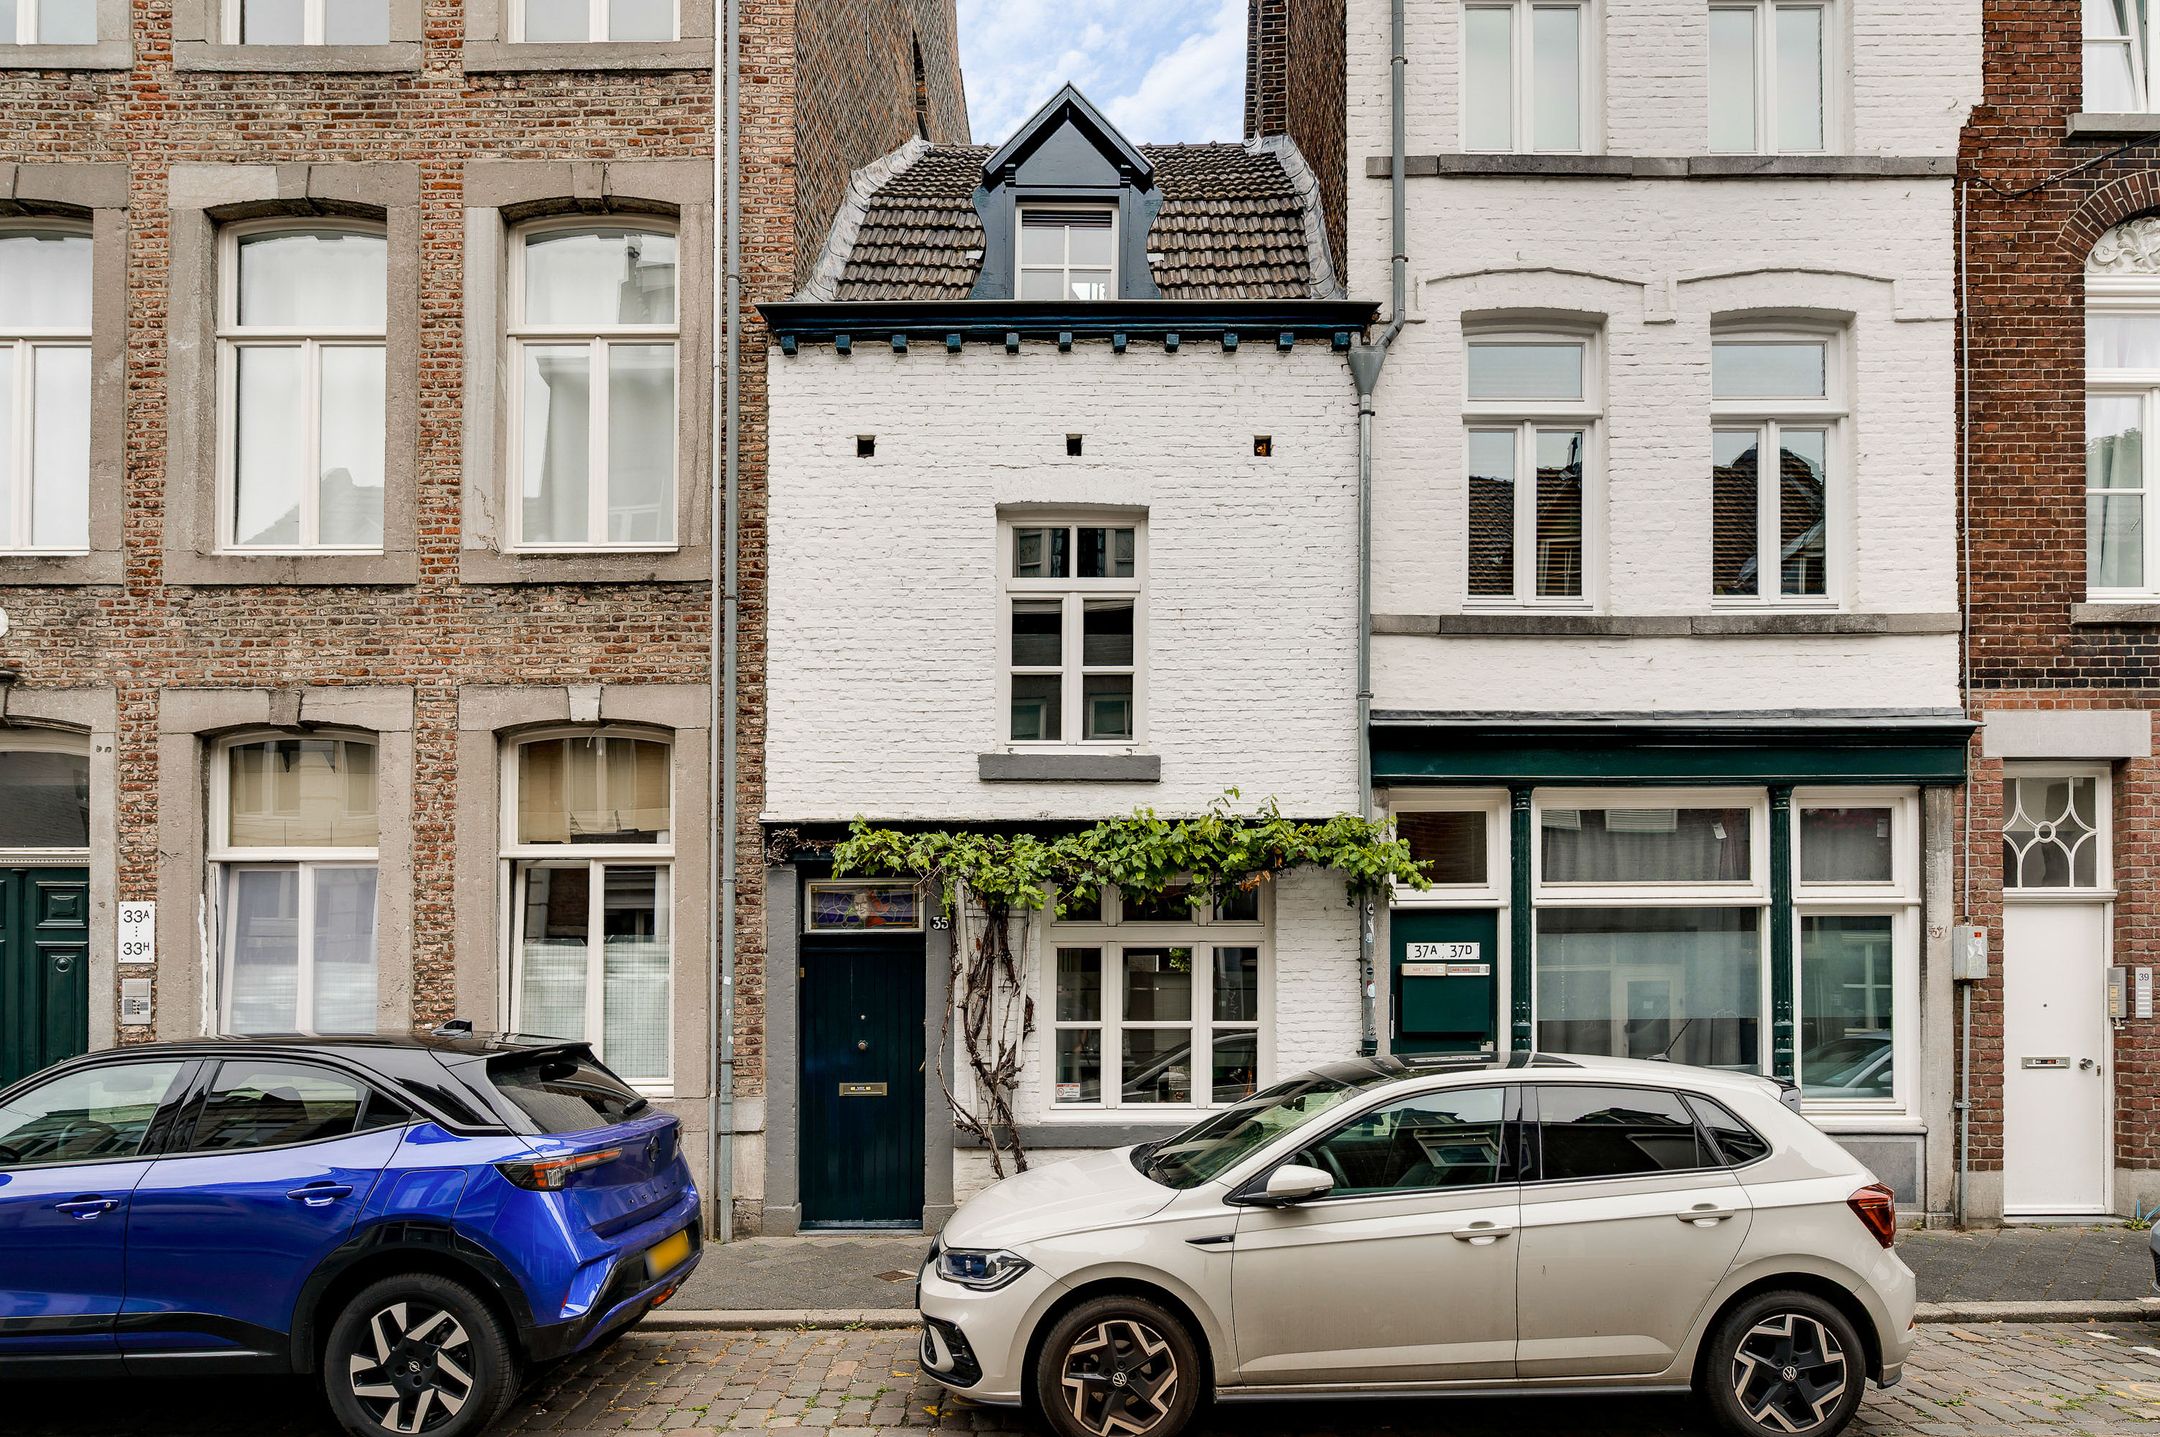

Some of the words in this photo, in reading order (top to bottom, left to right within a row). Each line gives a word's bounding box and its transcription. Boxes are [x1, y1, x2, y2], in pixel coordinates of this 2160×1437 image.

[123, 909, 150, 924] 33A
[932, 916, 949, 930] 35
[123, 941, 150, 956] 33H
[1414, 944, 1438, 959] 37A
[1449, 944, 1473, 959] 37D
[2138, 972, 2150, 982] 39
